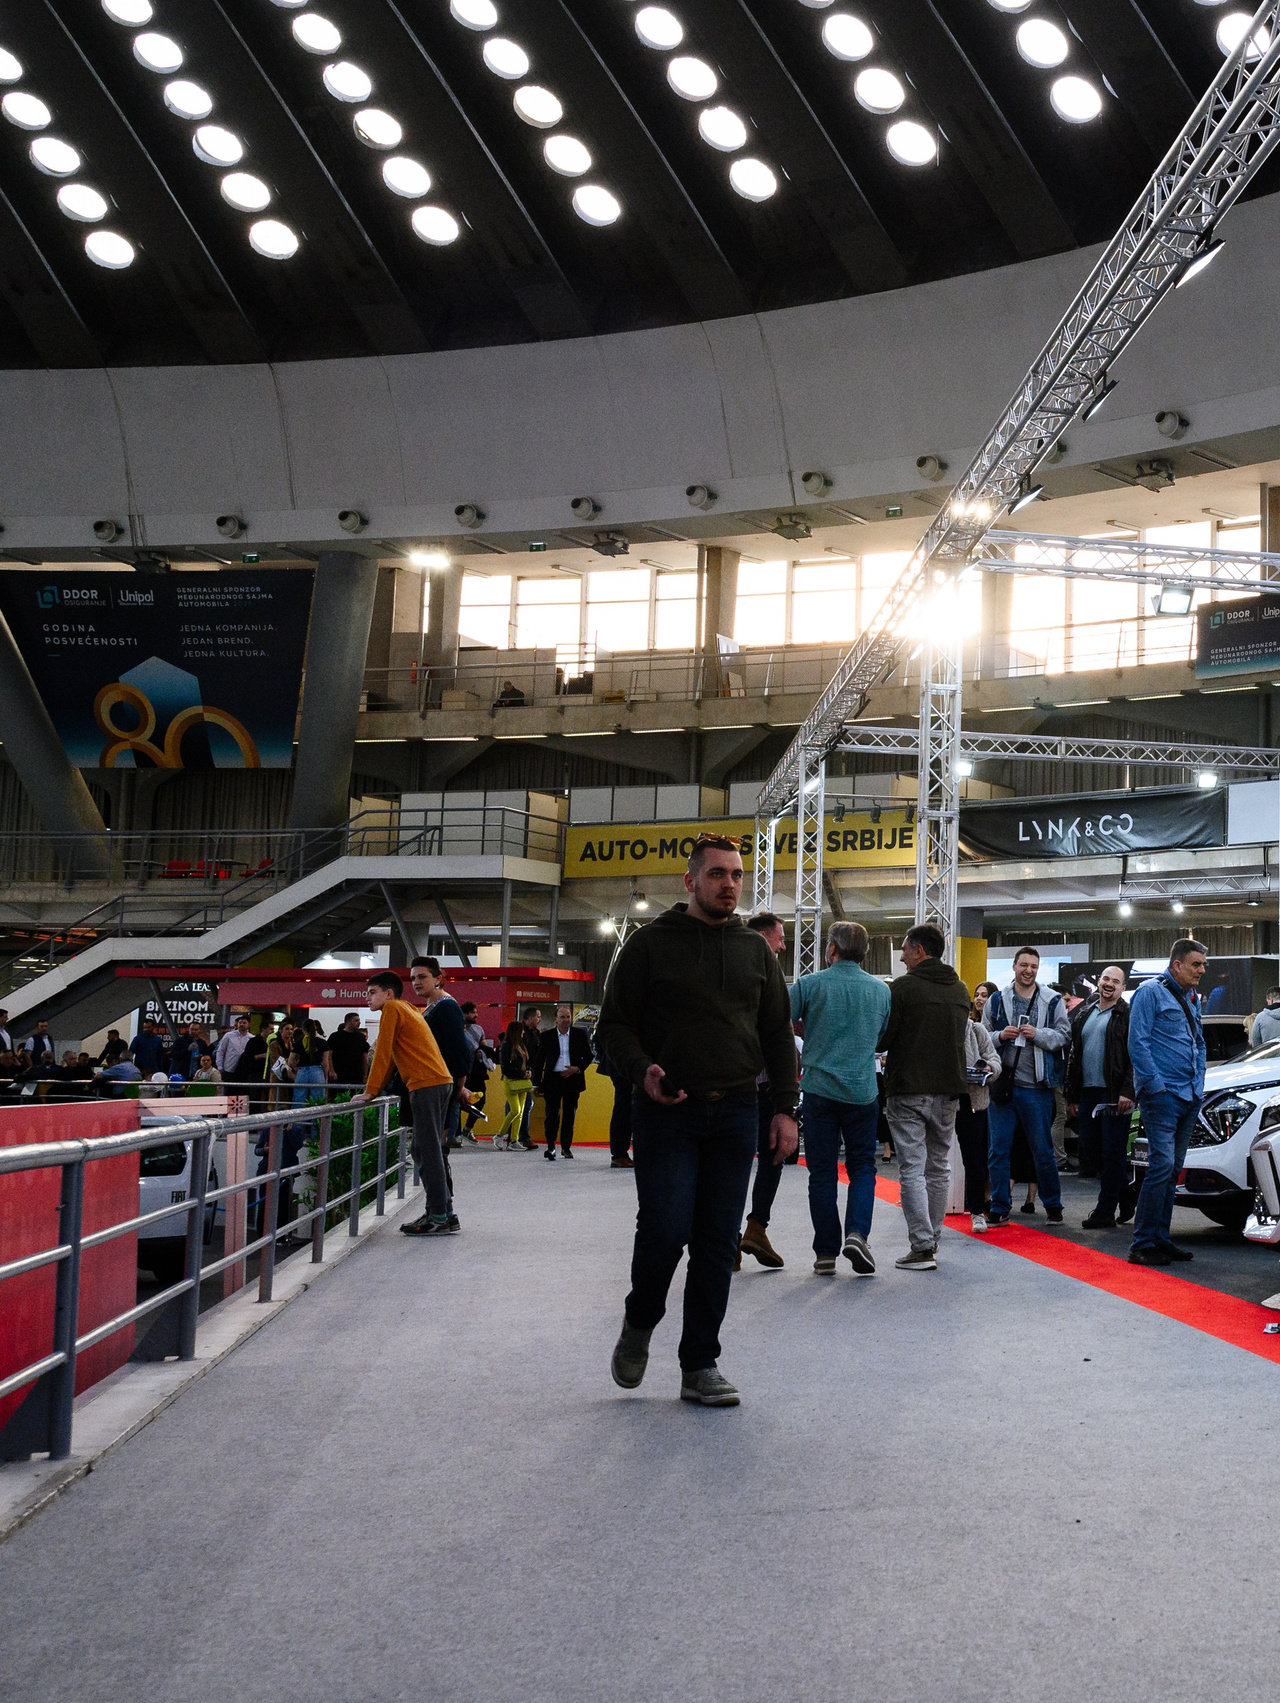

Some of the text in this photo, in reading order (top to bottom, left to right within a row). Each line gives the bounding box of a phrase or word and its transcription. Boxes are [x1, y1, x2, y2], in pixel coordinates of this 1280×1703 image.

[63, 589, 98, 600] DDOR
[120, 589, 154, 604] Unipol
[64, 599, 107, 607] OSIGURANJE
[1227, 609, 1250, 620] DDOR
[43, 624, 96, 632] GODINA
[180, 624, 278, 632] JEDNA KOMPANIJA.
[181, 637, 254, 645] JEDAN BREND.
[1211, 641, 1277, 654] GENERALNI SPONZOR
[183, 650, 270, 658] JEDNA KULTURA.
[1211, 657, 1251, 666] AUTOMOBILA
[827, 827, 914, 852] SRBIJE
[145, 1012, 216, 1024] SVTLOSTI
